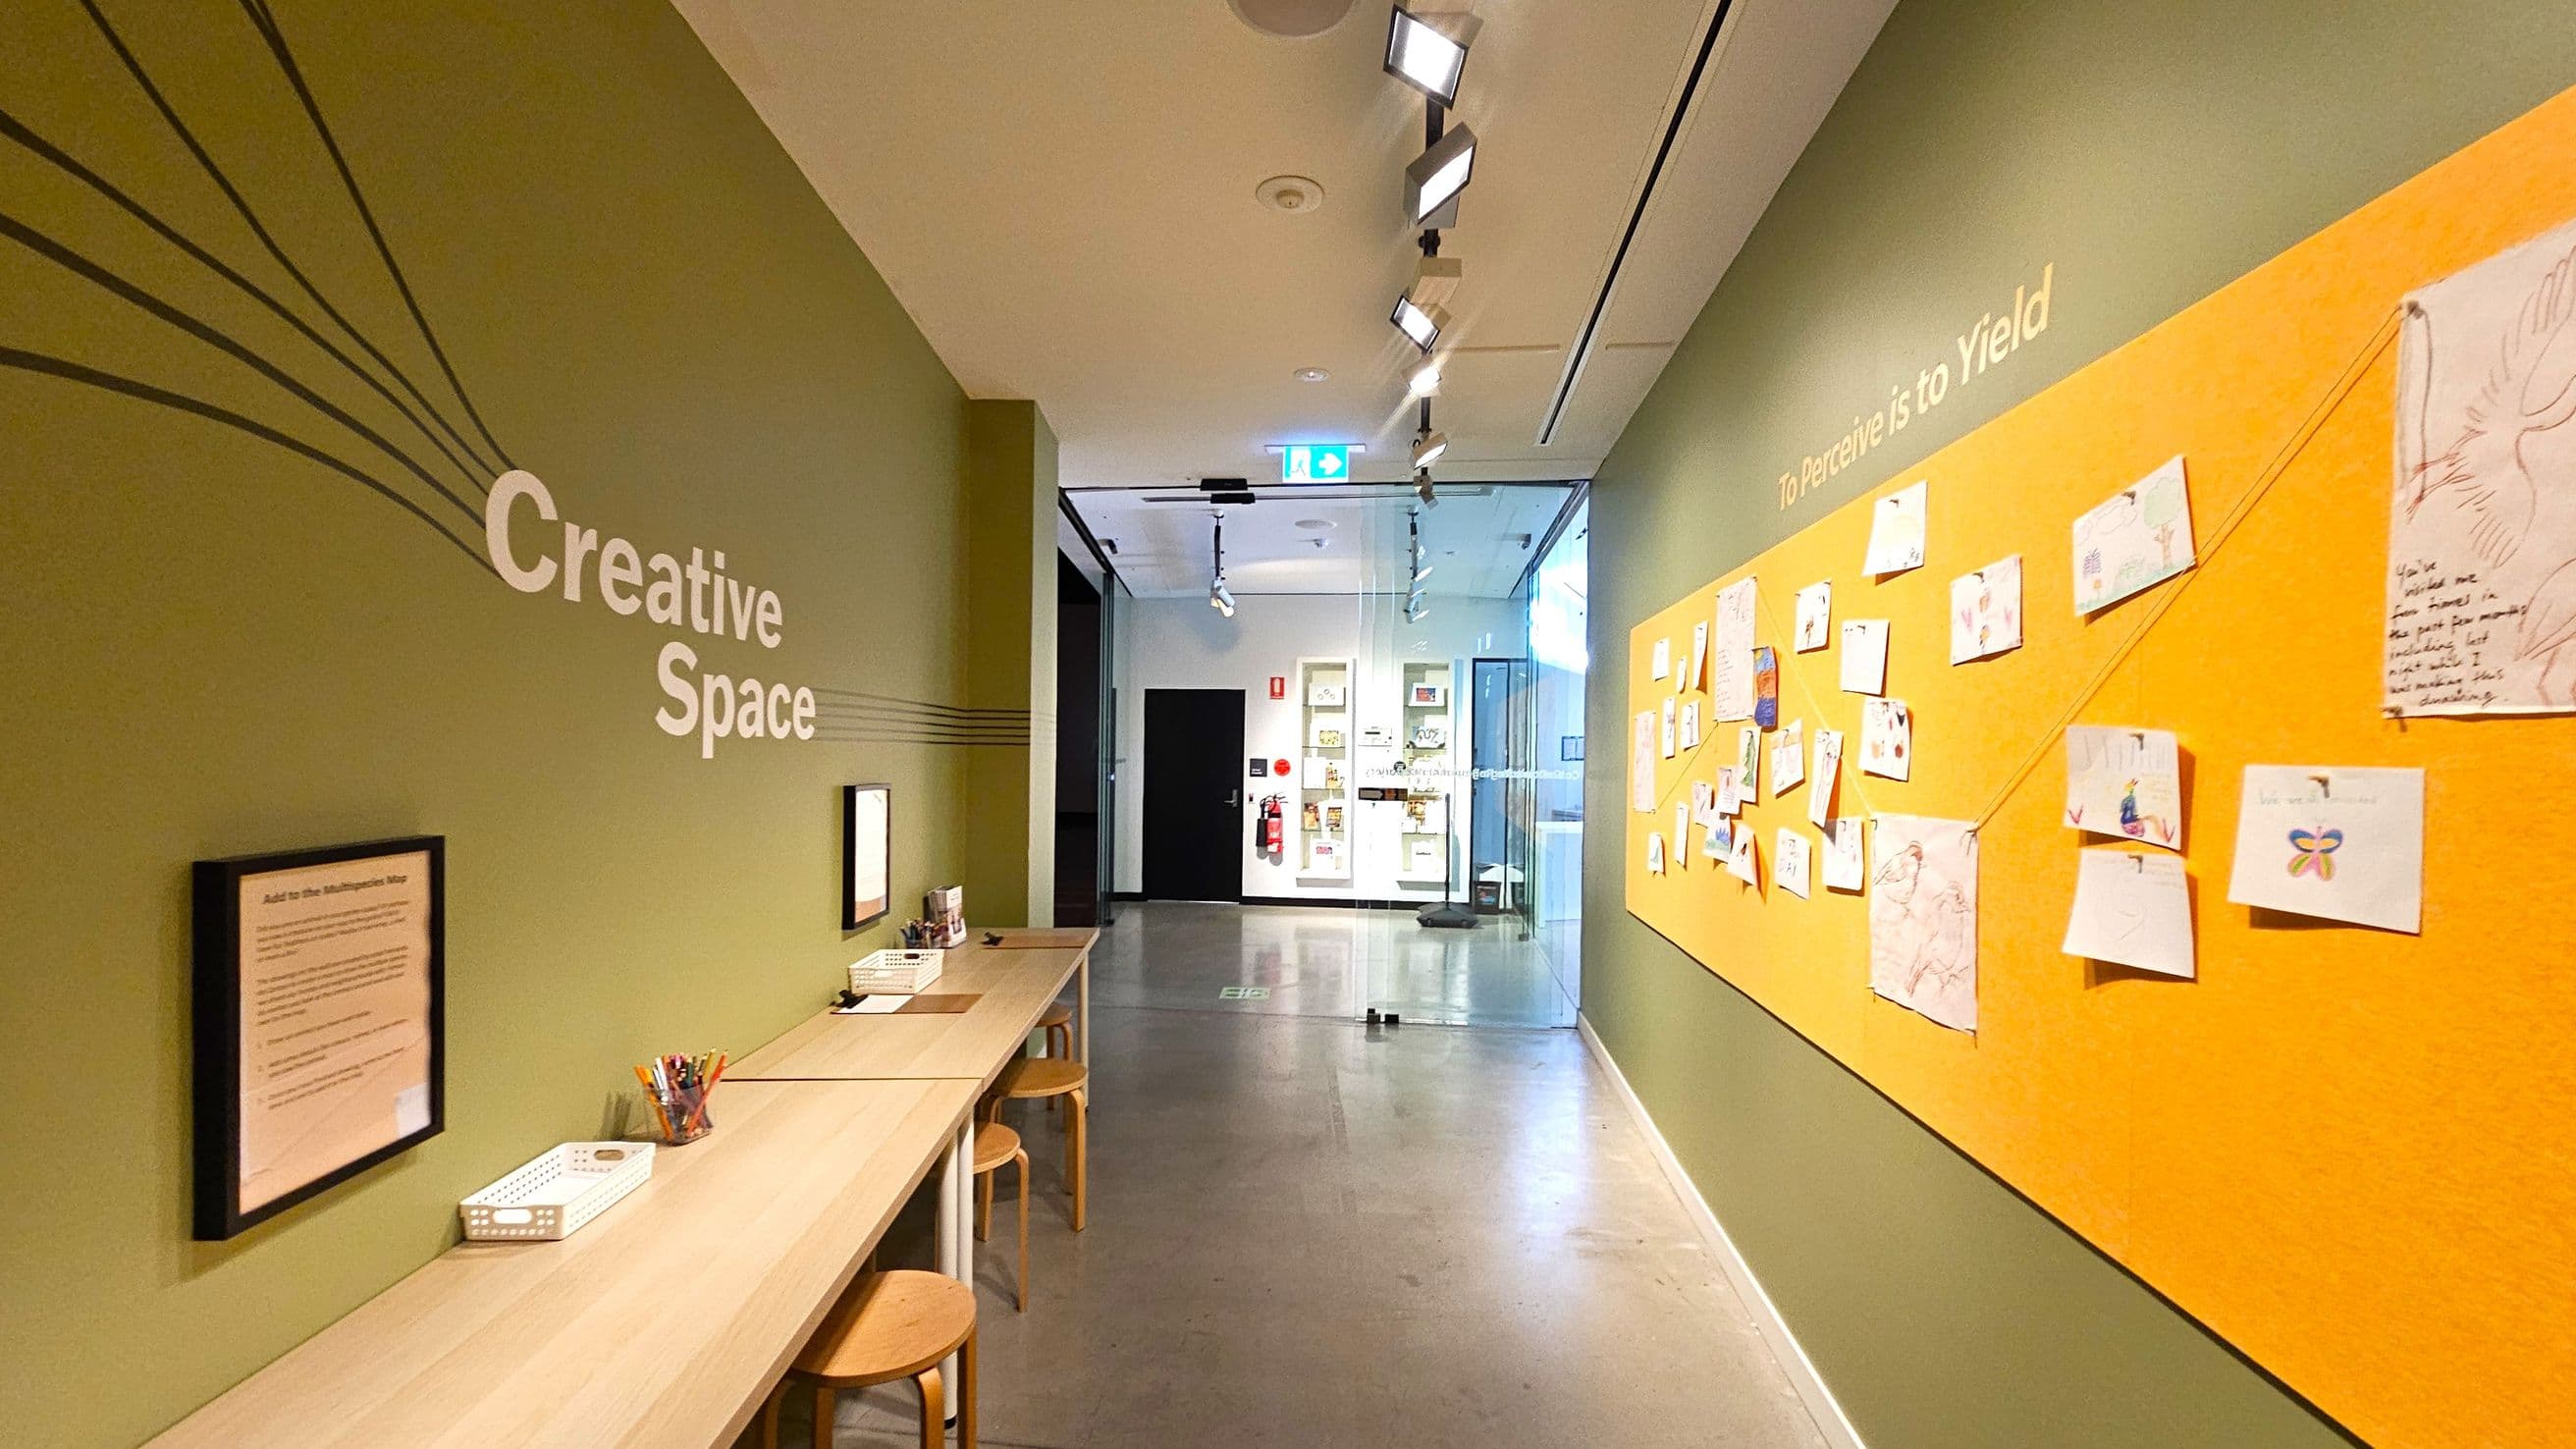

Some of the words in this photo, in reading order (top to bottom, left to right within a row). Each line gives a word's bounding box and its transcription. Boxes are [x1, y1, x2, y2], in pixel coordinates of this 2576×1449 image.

[1779, 471, 1798, 510] To
[1800, 411, 1884, 497] Perceive
[1889, 385, 1910, 436] is
[1916, 363, 1949, 415] to
[1957, 261, 2054, 386] Yield
[486, 469, 782, 648] Creative
[2395, 560, 2437, 589] You've
[2405, 577, 2444, 598] visited
[2455, 574, 2479, 585] me
[2428, 594, 2470, 612] times
[2482, 589, 2498, 601] in
[2389, 629, 2409, 639] the
[2417, 619, 2443, 642] past
[2451, 616, 2475, 634] few
[2389, 638, 2455, 659] including
[2466, 631, 2490, 646] last
[2389, 662, 2421, 681] night
[2430, 655, 2463, 670] while
[2472, 652, 2481, 667] I
[2389, 684, 2411, 694] was
[2472, 669, 2504, 681] this
[655, 641, 816, 759] Space
[263, 891, 287, 904] Add
[289, 891, 299, 900] to
[302, 887, 321, 898] the
[387, 875, 407, 885] Map
